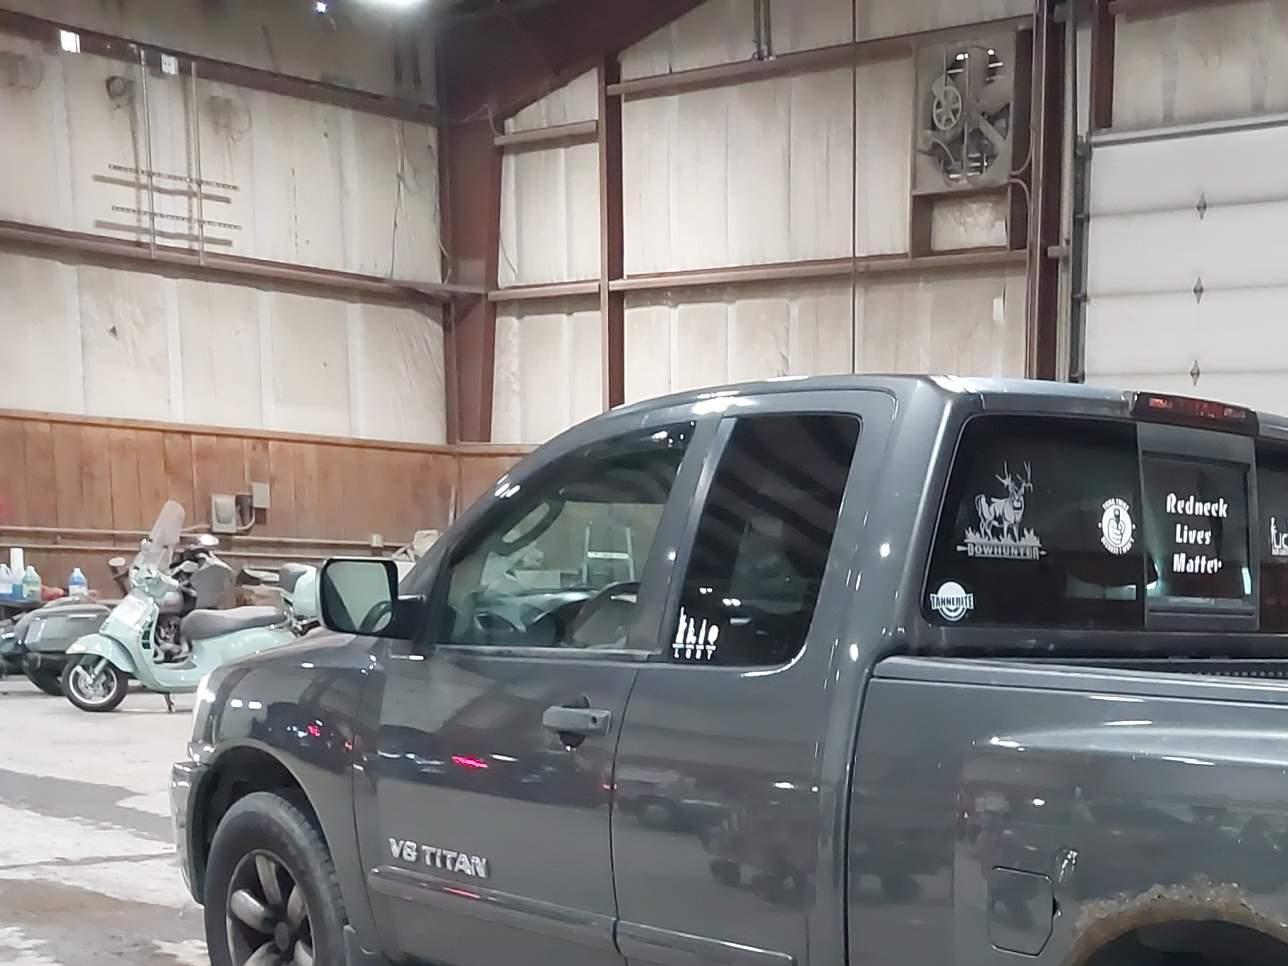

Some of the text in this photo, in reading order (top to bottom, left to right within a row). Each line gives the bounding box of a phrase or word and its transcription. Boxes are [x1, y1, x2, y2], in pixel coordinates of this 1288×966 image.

[1166, 492, 1228, 518] Redneck
[1175, 523, 1212, 545] Lives
[1173, 552, 1223, 574] Matter
[388, 837, 487, 879] V8 TITAN
